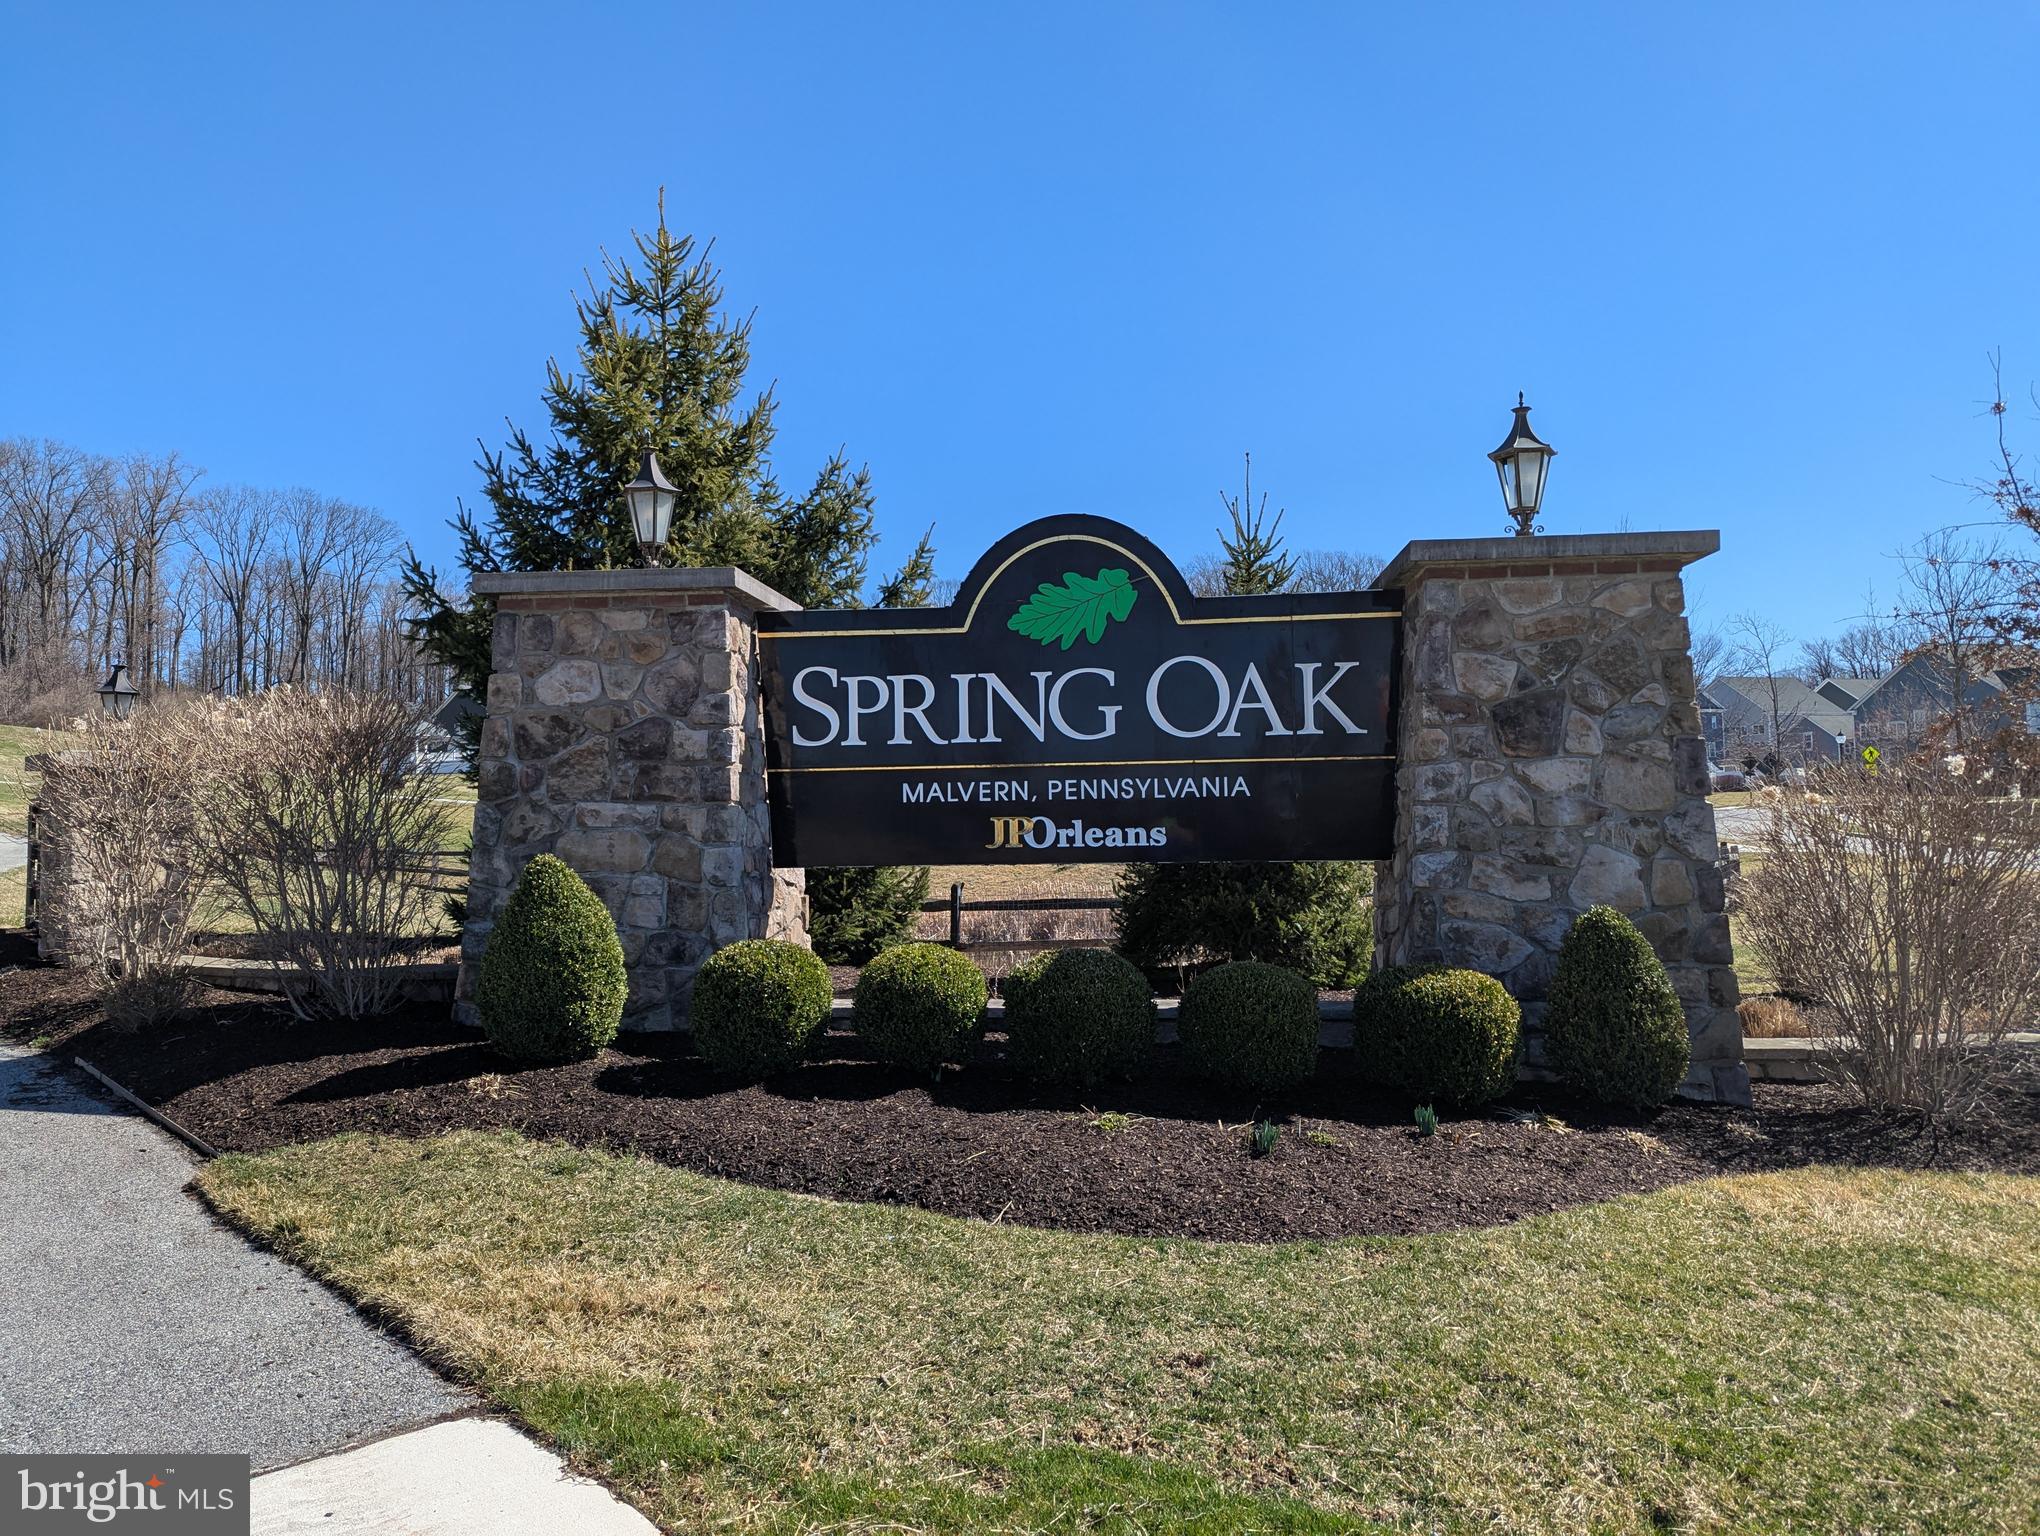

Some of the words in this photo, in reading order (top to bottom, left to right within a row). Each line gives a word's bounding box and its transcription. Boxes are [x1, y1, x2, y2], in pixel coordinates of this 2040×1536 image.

[792, 666, 1123, 747] SPRING
[1145, 655, 1368, 738] OAK
[902, 780, 1037, 803] MALVERN,
[1048, 776, 1251, 801] PENNSYLVANIA
